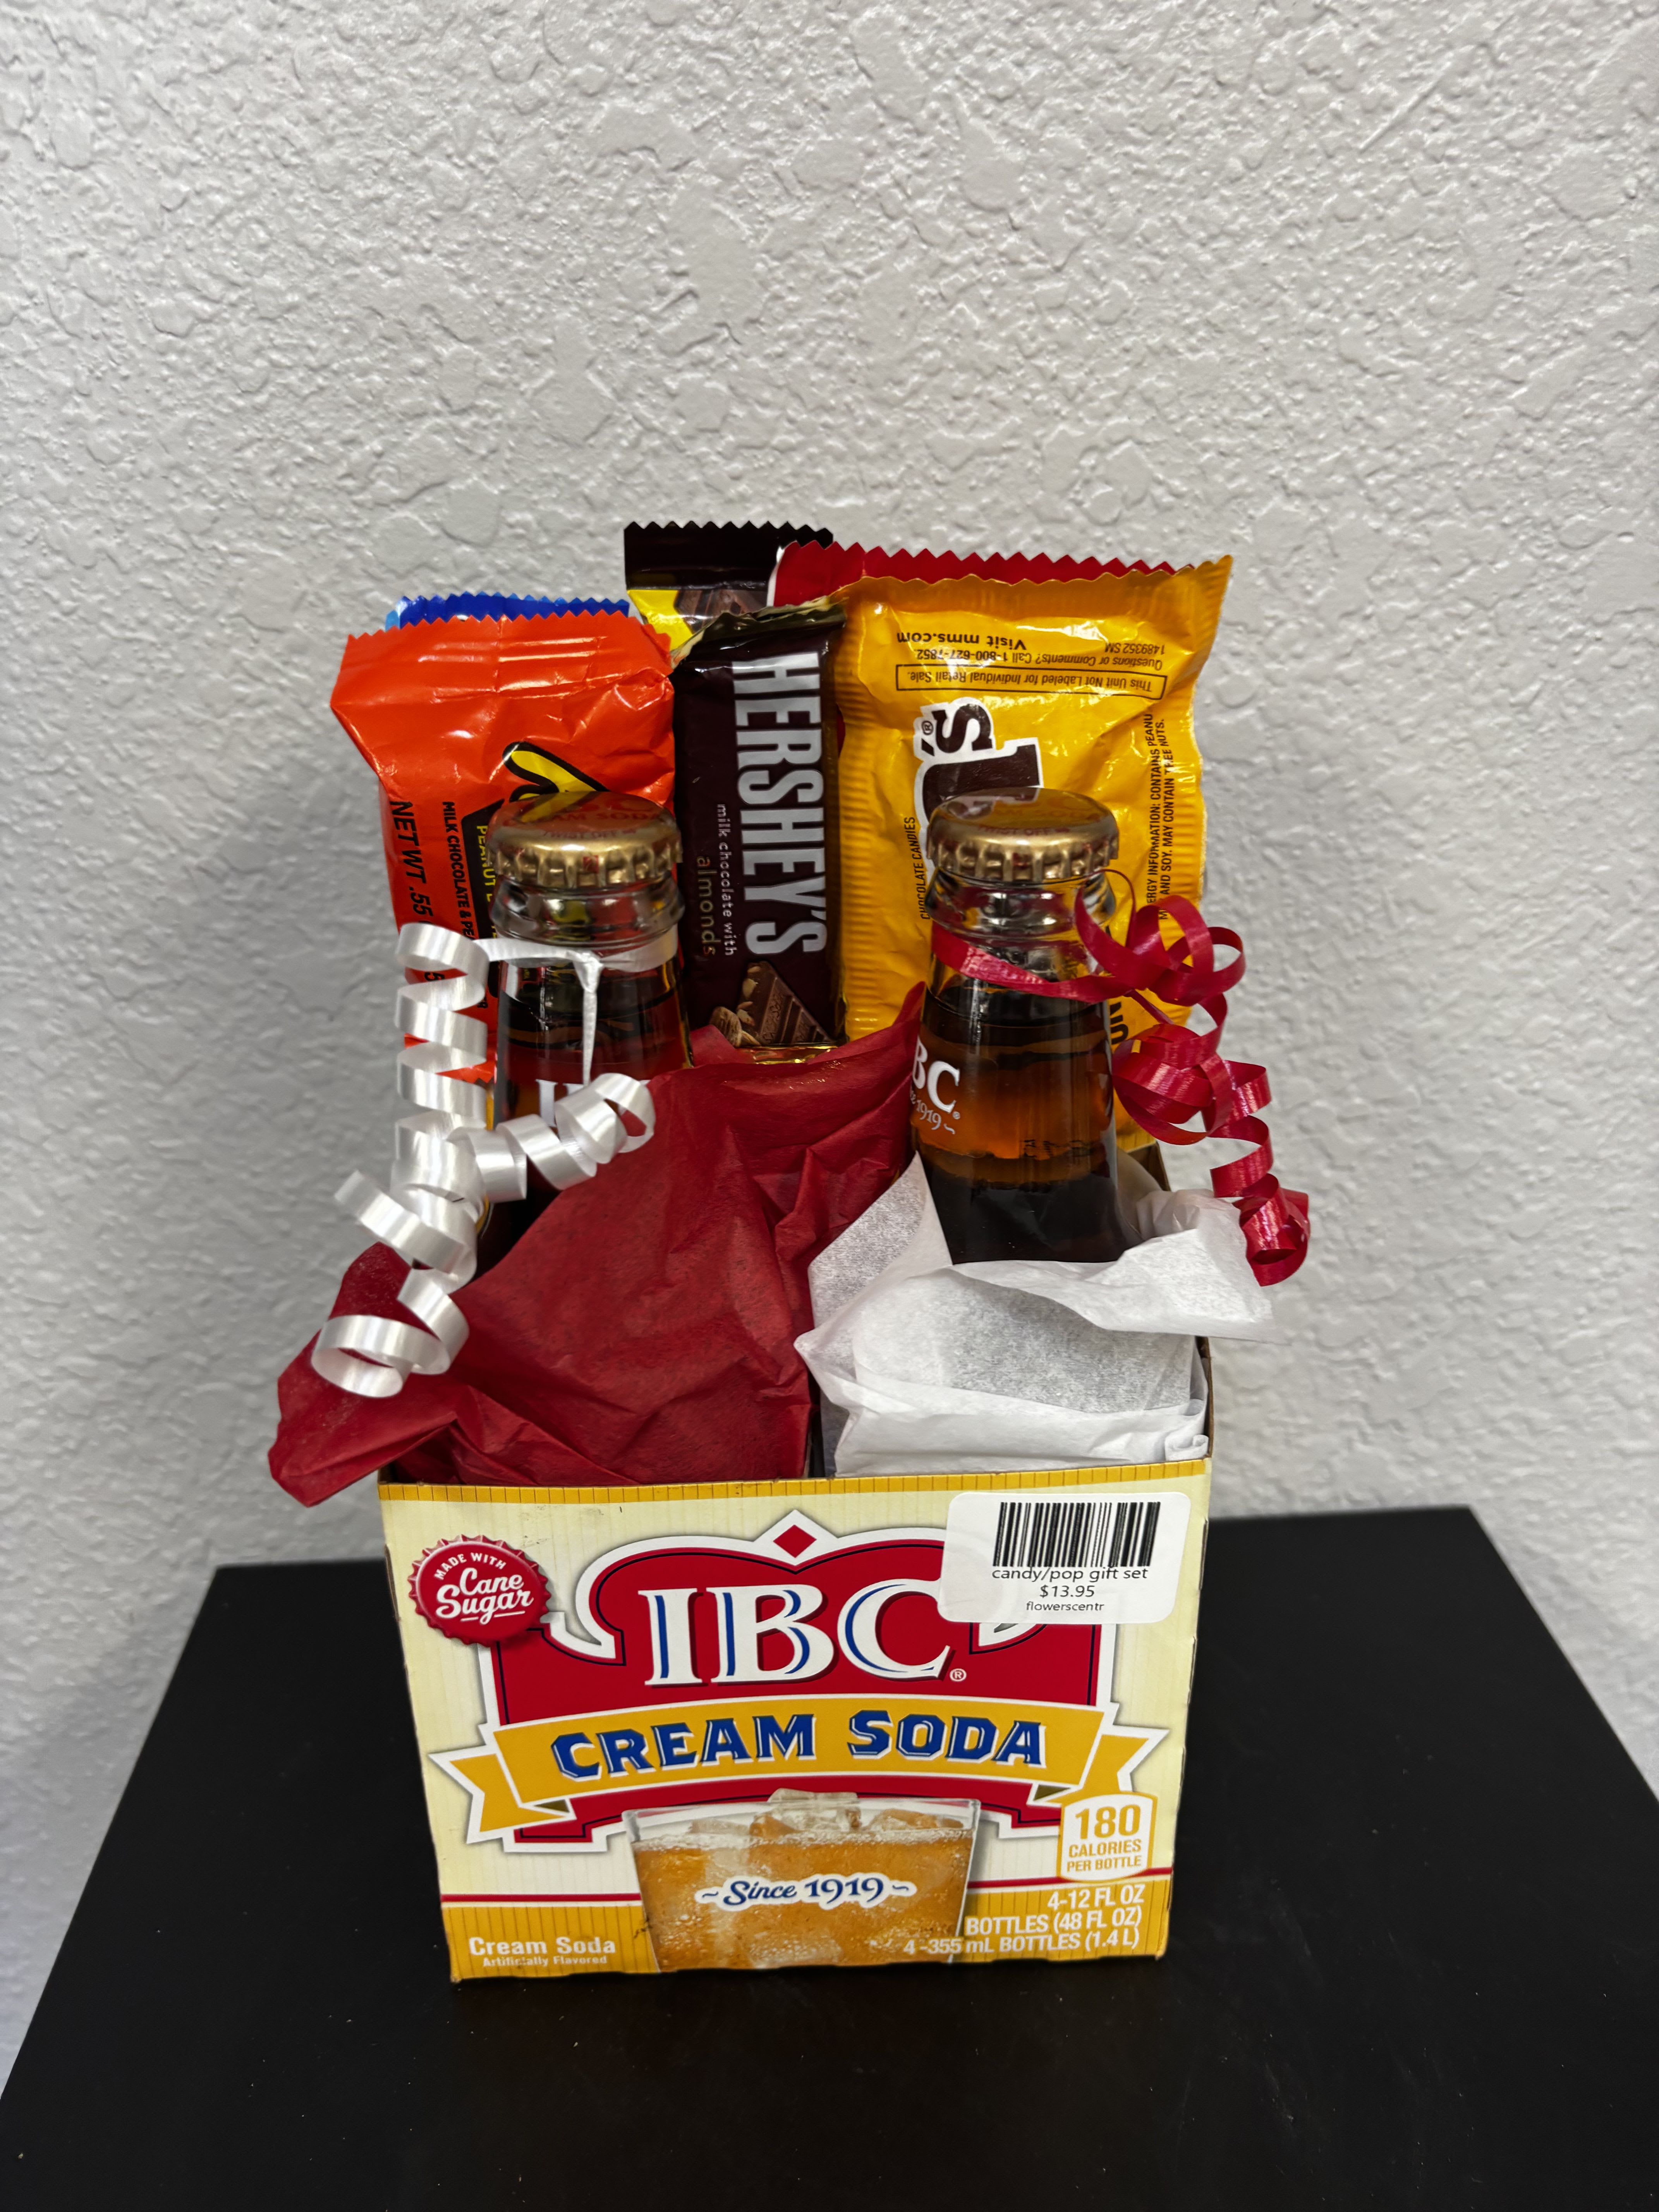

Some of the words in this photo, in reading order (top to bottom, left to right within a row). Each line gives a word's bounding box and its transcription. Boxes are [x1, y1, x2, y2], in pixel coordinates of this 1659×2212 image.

[897, 632, 979, 644] mms.com
[986, 635, 1026, 650] Visit
[1124, 642, 1165, 655] 1489352
[1012, 652, 1032, 663] Call
[1036, 653, 1096, 666] Comments?
[1099, 657, 1109, 665] or
[1113, 657, 1163, 671] Questions
[907, 671, 931, 683] Sale.
[935, 671, 965, 682] Retail
[970, 673, 1022, 685] Individual
[1024, 674, 1038, 683] for
[1042, 675, 1082, 686] Labeled
[1085, 676, 1103, 687] Not
[1106, 677, 1127, 689] Unit
[1131, 679, 1152, 692] This
[1143, 714, 1158, 746] PEANU
[1155, 719, 1170, 746] NUTS.
[1150, 749, 1161, 800] CONTAINS
[732, 652, 828, 955] HERSHEY'S
[1163, 778, 1175, 822] CONTAIN
[389, 801, 420, 847] NET
[442, 801, 459, 833] MILK
[717, 804, 731, 838] milk
[903, 817, 922, 860] CANDIES
[1147, 804, 1161, 875] INFORMATION:
[1163, 825, 1173, 847] MAY
[402, 850, 426, 884] WT
[447, 835, 470, 908] CHOCOLATE
[1161, 850, 1173, 871] SOY.
[719, 842, 734, 917] chocolate
[1160, 874, 1171, 895] AND
[697, 856, 721, 956] almonds
[723, 922, 737, 956] with
[916, 1099, 941, 1130] 1919
[434, 1553, 467, 1580] MADE
[470, 1552, 507, 1570] WITH
[992, 1567, 1084, 1583] candy/pop
[1089, 1567, 1119, 1583] gift
[1123, 1568, 1149, 1579] set
[459, 1567, 524, 1595] Cane
[1039, 1585, 1096, 1598] $13.95
[436, 1584, 534, 1625] Sugar
[1026, 1601, 1105, 1611] flowerscentr
[551, 1714, 817, 1782] CREAM
[847, 1710, 1047, 1769] SODA
[1075, 1804, 1141, 1840] 180
[1068, 1838, 1142, 1858] CALORIES
[1066, 1860, 1091, 1873] PER
[1095, 1855, 1142, 1870] BOTTLE
[723, 1880, 797, 1906] Since
[804, 1877, 883, 1904] 1919
[1047, 1889, 1090, 1910] 4-12
[1094, 1887, 1116, 1907] FL
[1120, 1884, 1146, 1905] OZ
[966, 1914, 1049, 1936] BOTTLES
[1053, 1911, 1082, 1934] (48
[1086, 1909, 1107, 1930] FL
[1111, 1905, 1143, 1927] OZ)
[469, 1937, 548, 1956] Cream
[556, 1936, 616, 1954] Soda
[965, 1937, 995, 1954] mL
[999, 1934, 1081, 1953] BOTTLES
[1085, 1930, 1118, 1952] (1.4
[1122, 1927, 1140, 1949] L)
[483, 1956, 548, 1967] Artificially
[553, 1955, 607, 1965] Flavored
